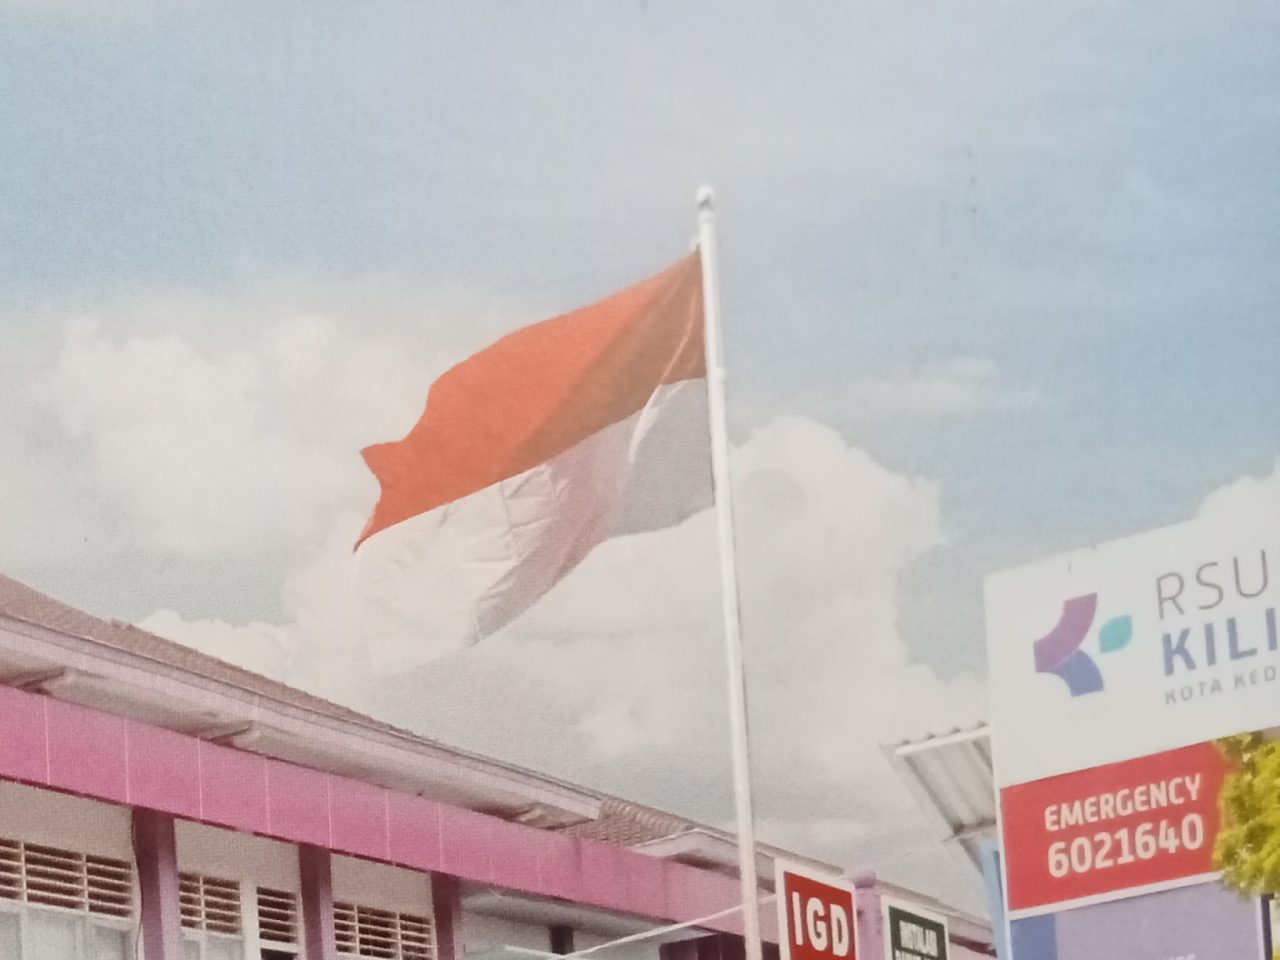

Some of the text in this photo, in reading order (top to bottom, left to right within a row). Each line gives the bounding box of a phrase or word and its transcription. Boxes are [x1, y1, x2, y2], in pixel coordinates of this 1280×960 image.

[1156, 549, 1269, 620] RSU
[1164, 678, 1223, 705] KOTA
[1044, 773, 1203, 831] EMERGENCY
[1047, 813, 1204, 878] 6021640
[792, 891, 850, 957] IGD
